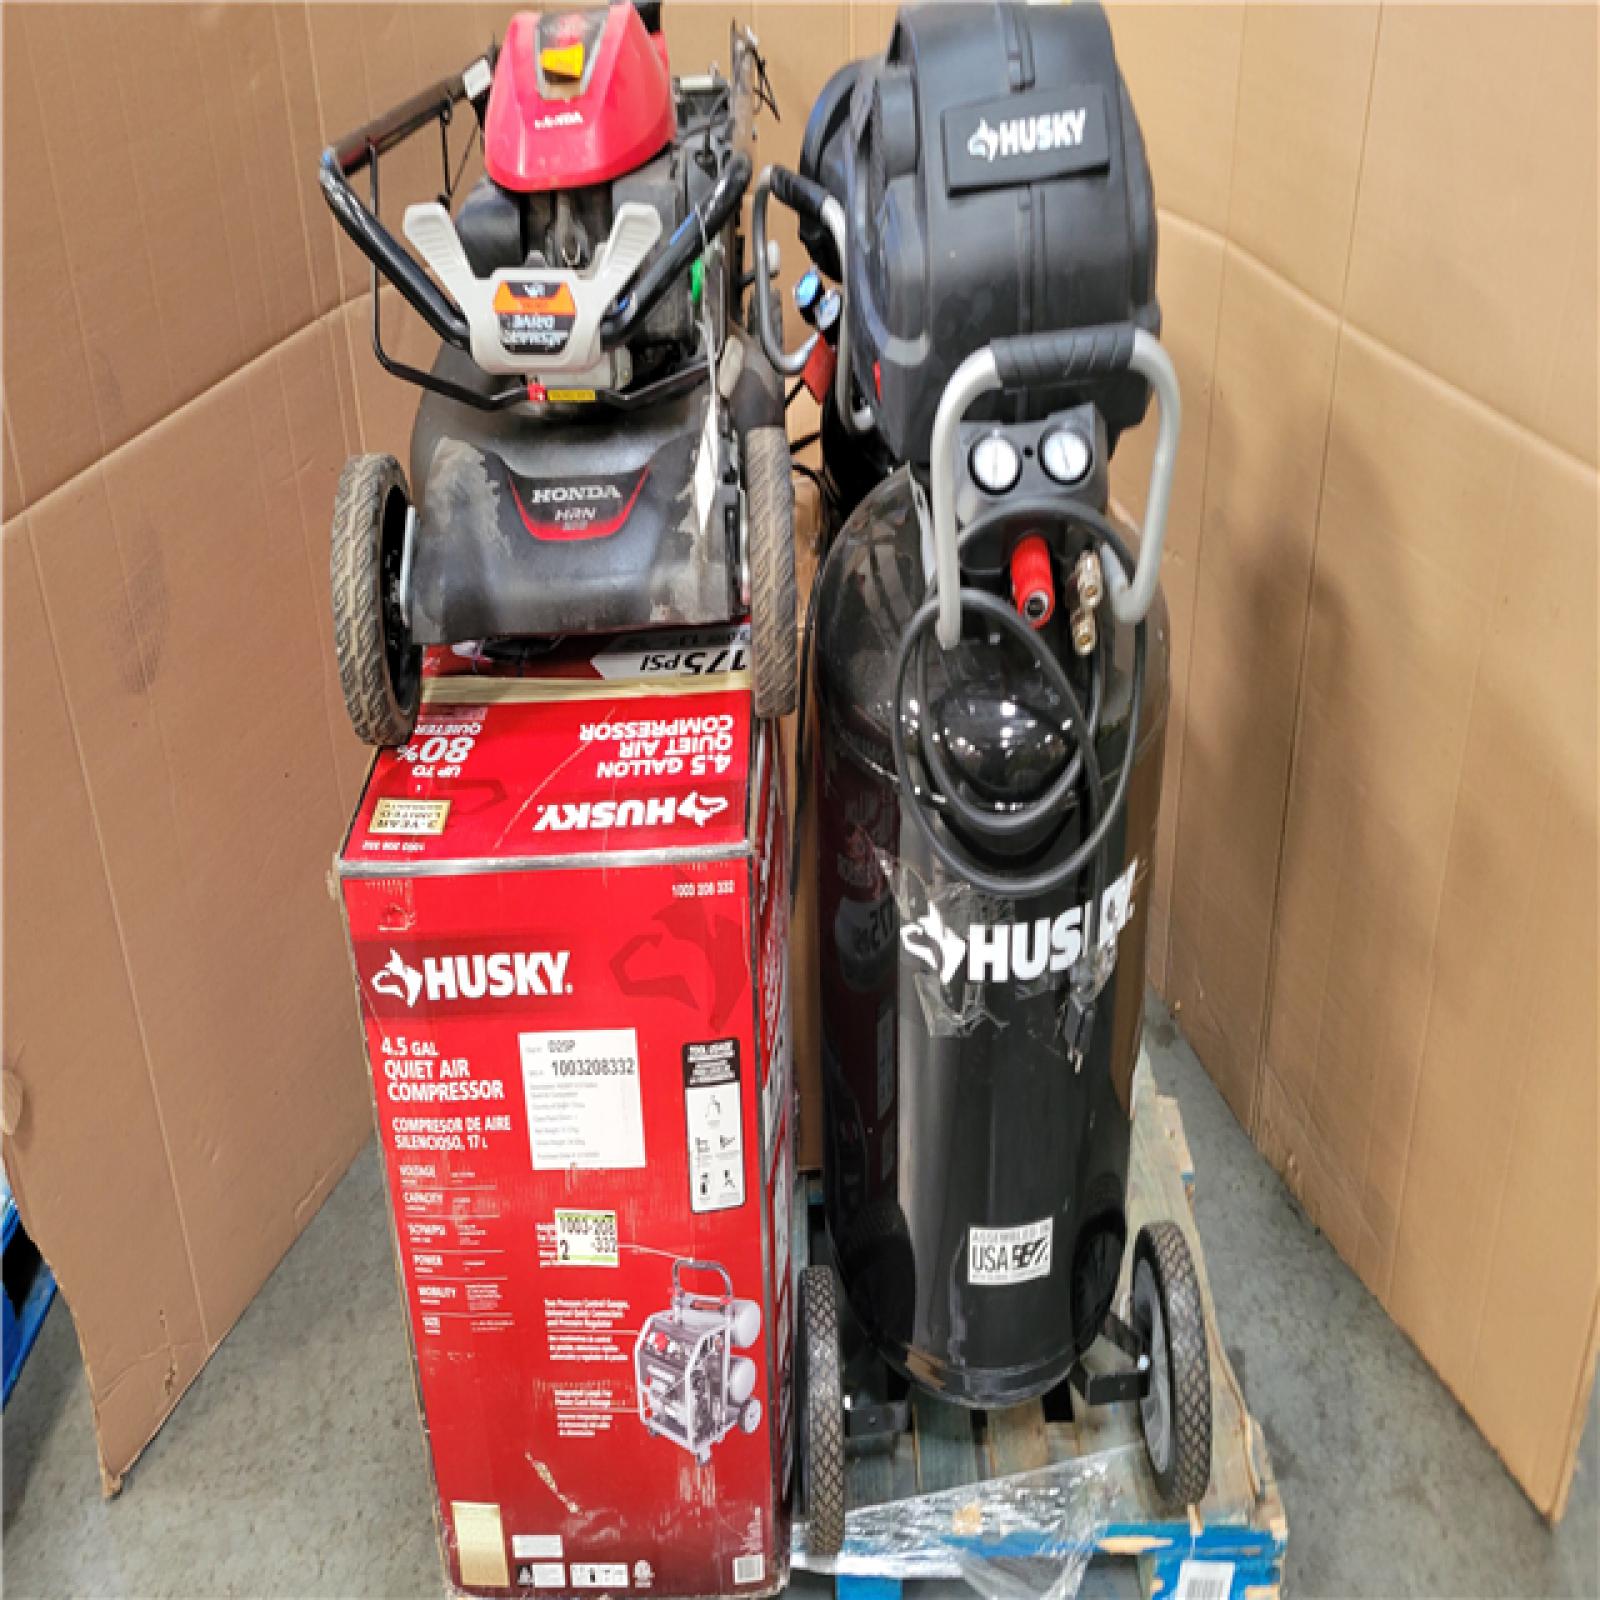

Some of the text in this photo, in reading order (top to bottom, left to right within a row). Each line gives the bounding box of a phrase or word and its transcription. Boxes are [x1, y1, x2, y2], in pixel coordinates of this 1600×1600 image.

[999, 107, 1087, 156] HUSKY
[531, 485, 622, 504] HONDA
[639, 649, 749, 676] 175 PSI
[578, 714, 734, 742] COMPRESSOR
[618, 734, 734, 759] QUIET AIR
[437, 764, 462, 779] UP
[596, 751, 732, 779] 4.5 GALLON
[382, 1036, 440, 1057] 4.5 GAL
[384, 1057, 471, 1081] QUIET AIR
[551, 1057, 636, 1076] 1003208332
[387, 1080, 506, 1103] COMPRESSOR
[392, 1114, 511, 1133] COMPRESOR DE AIRE
[972, 1244, 1008, 1271] USA
